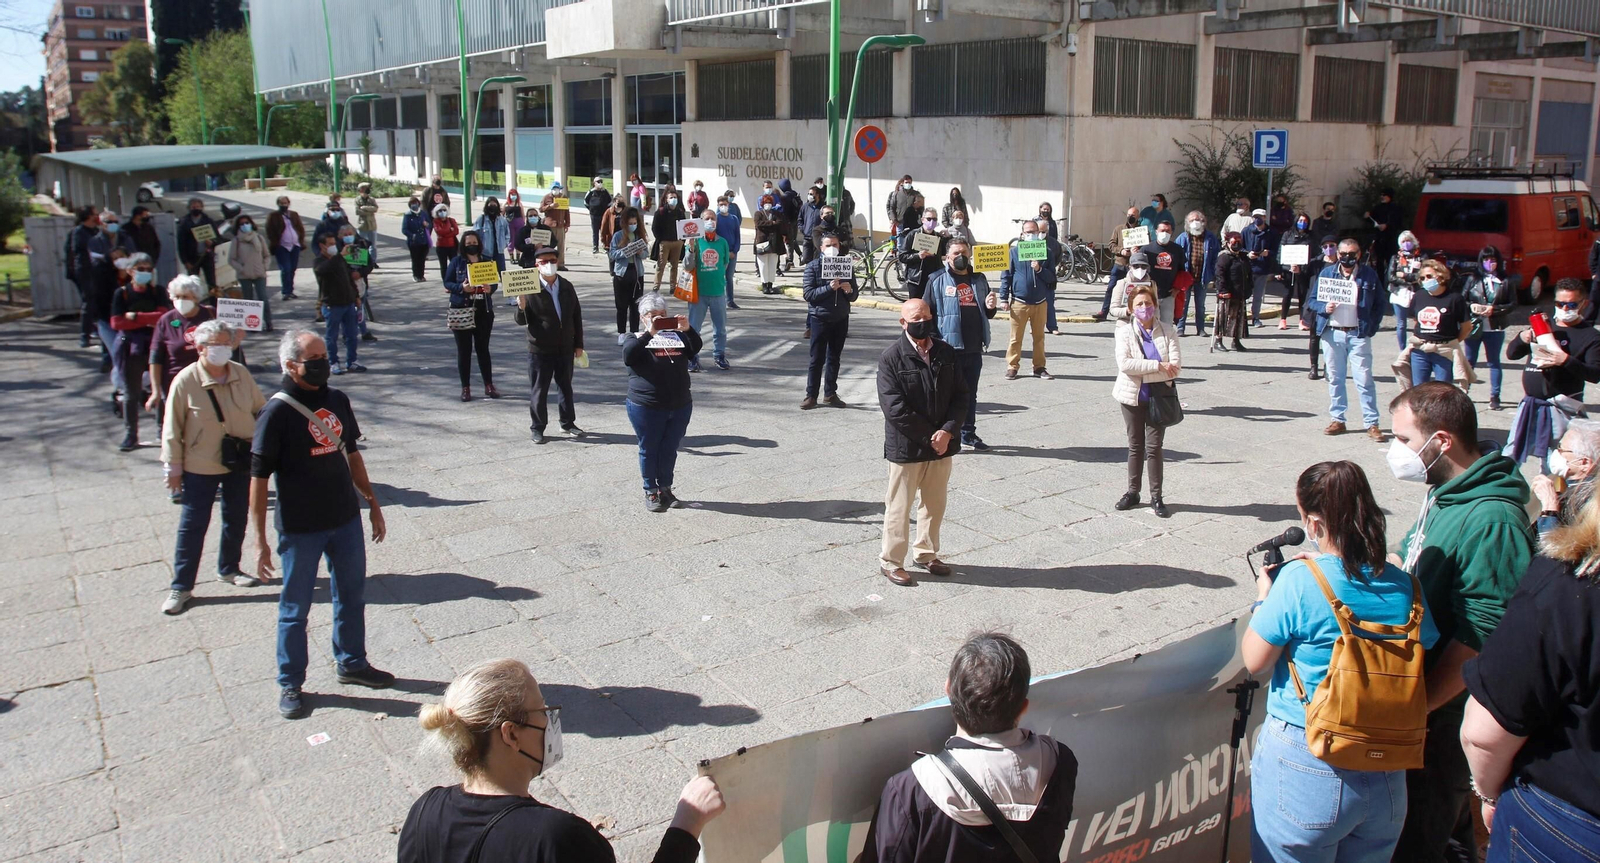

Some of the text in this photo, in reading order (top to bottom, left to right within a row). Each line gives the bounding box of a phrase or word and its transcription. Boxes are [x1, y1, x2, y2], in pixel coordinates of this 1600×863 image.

[717, 146, 804, 162] SUBDELEGACION
[1260, 134, 1280, 163] P
[718, 164, 804, 181] DEL GOBIERNO
[1319, 286, 1340, 294] DIGNO
[1330, 280, 1353, 288] TRABAJO
[310, 414, 336, 437] SOP
[311, 448, 325, 456] 15M
